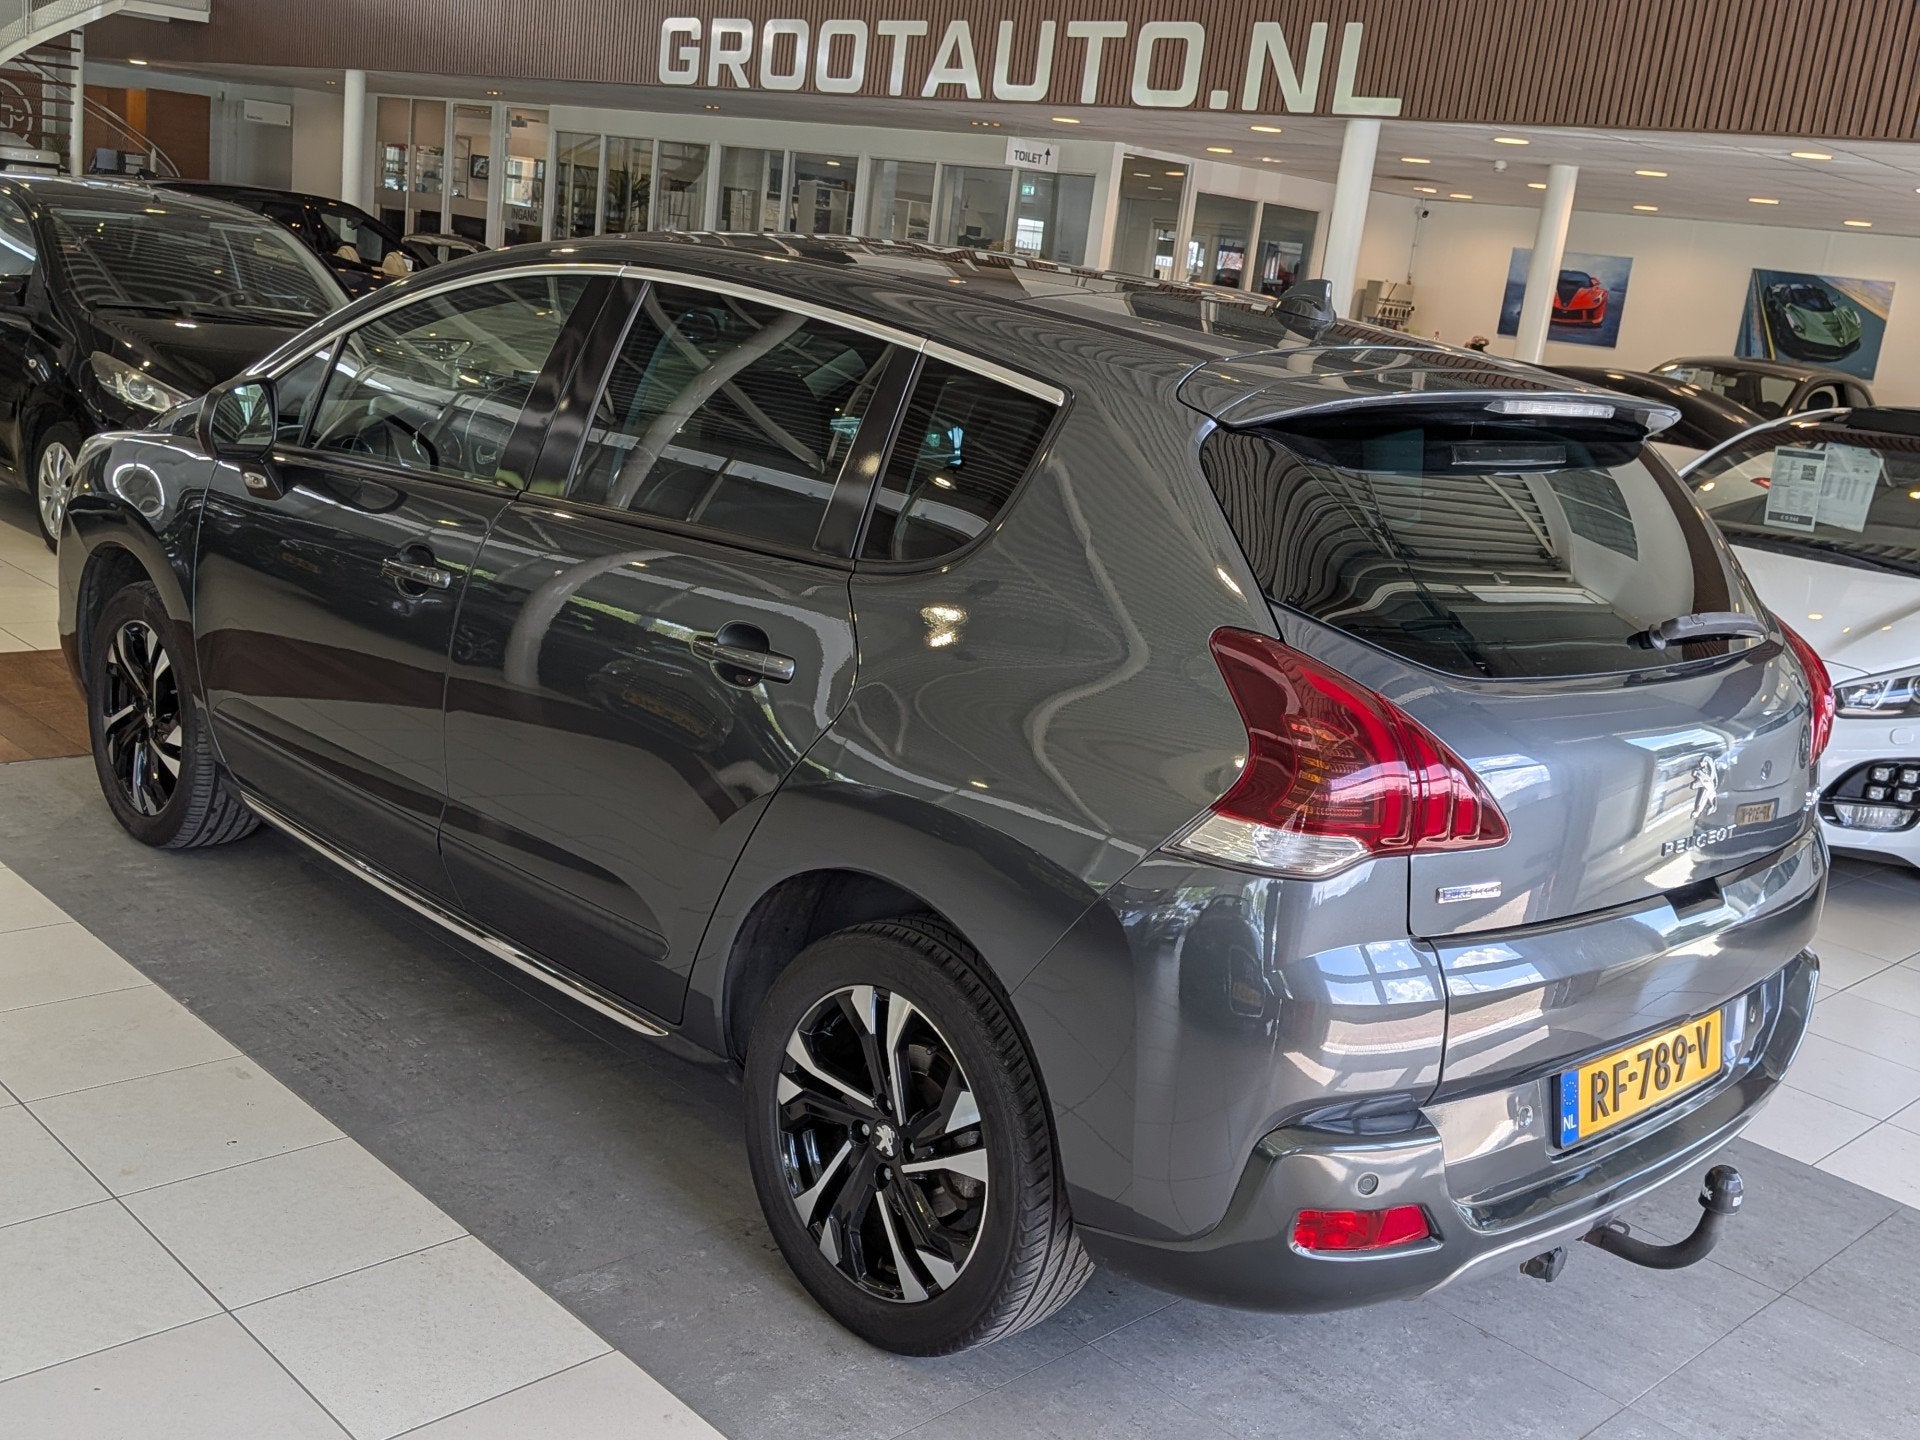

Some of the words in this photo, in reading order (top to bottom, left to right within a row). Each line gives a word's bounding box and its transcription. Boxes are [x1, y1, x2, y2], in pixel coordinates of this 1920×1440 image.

[658, 17, 1402, 116] GROOTAUTO.NL
[1014, 149, 1043, 165] TOILET
[511, 207, 538, 222] INGANG
[1661, 824, 1737, 857] PEUGEOT
[1590, 1021, 1712, 1123] RF-789-V
[1563, 1113, 1577, 1132] NL
